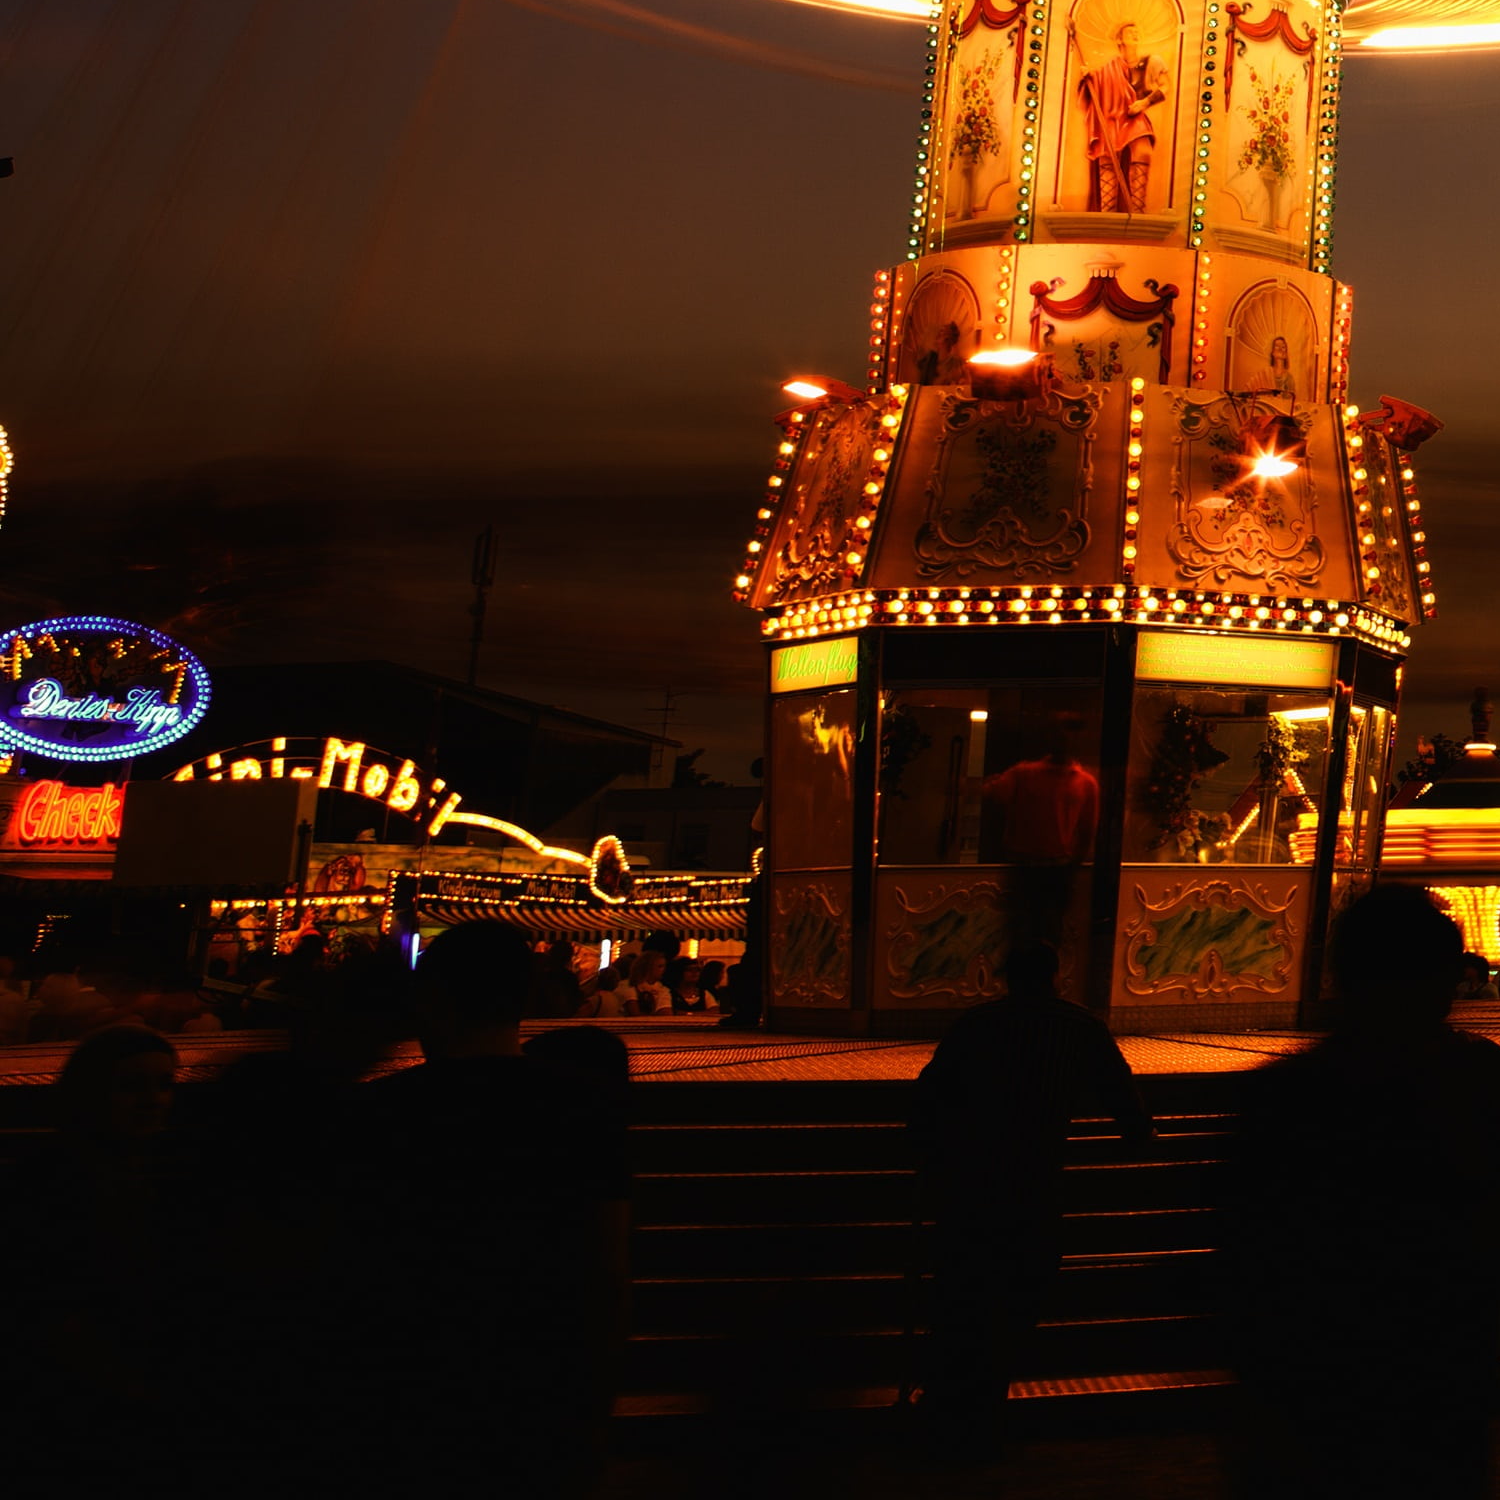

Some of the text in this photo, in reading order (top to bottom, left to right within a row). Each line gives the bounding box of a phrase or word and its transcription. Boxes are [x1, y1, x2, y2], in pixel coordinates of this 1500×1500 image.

[778, 641, 858, 685] Wellenflug
[20, 780, 120, 840] Check
[437, 879, 576, 898] Kindertraum Mini Mobil
